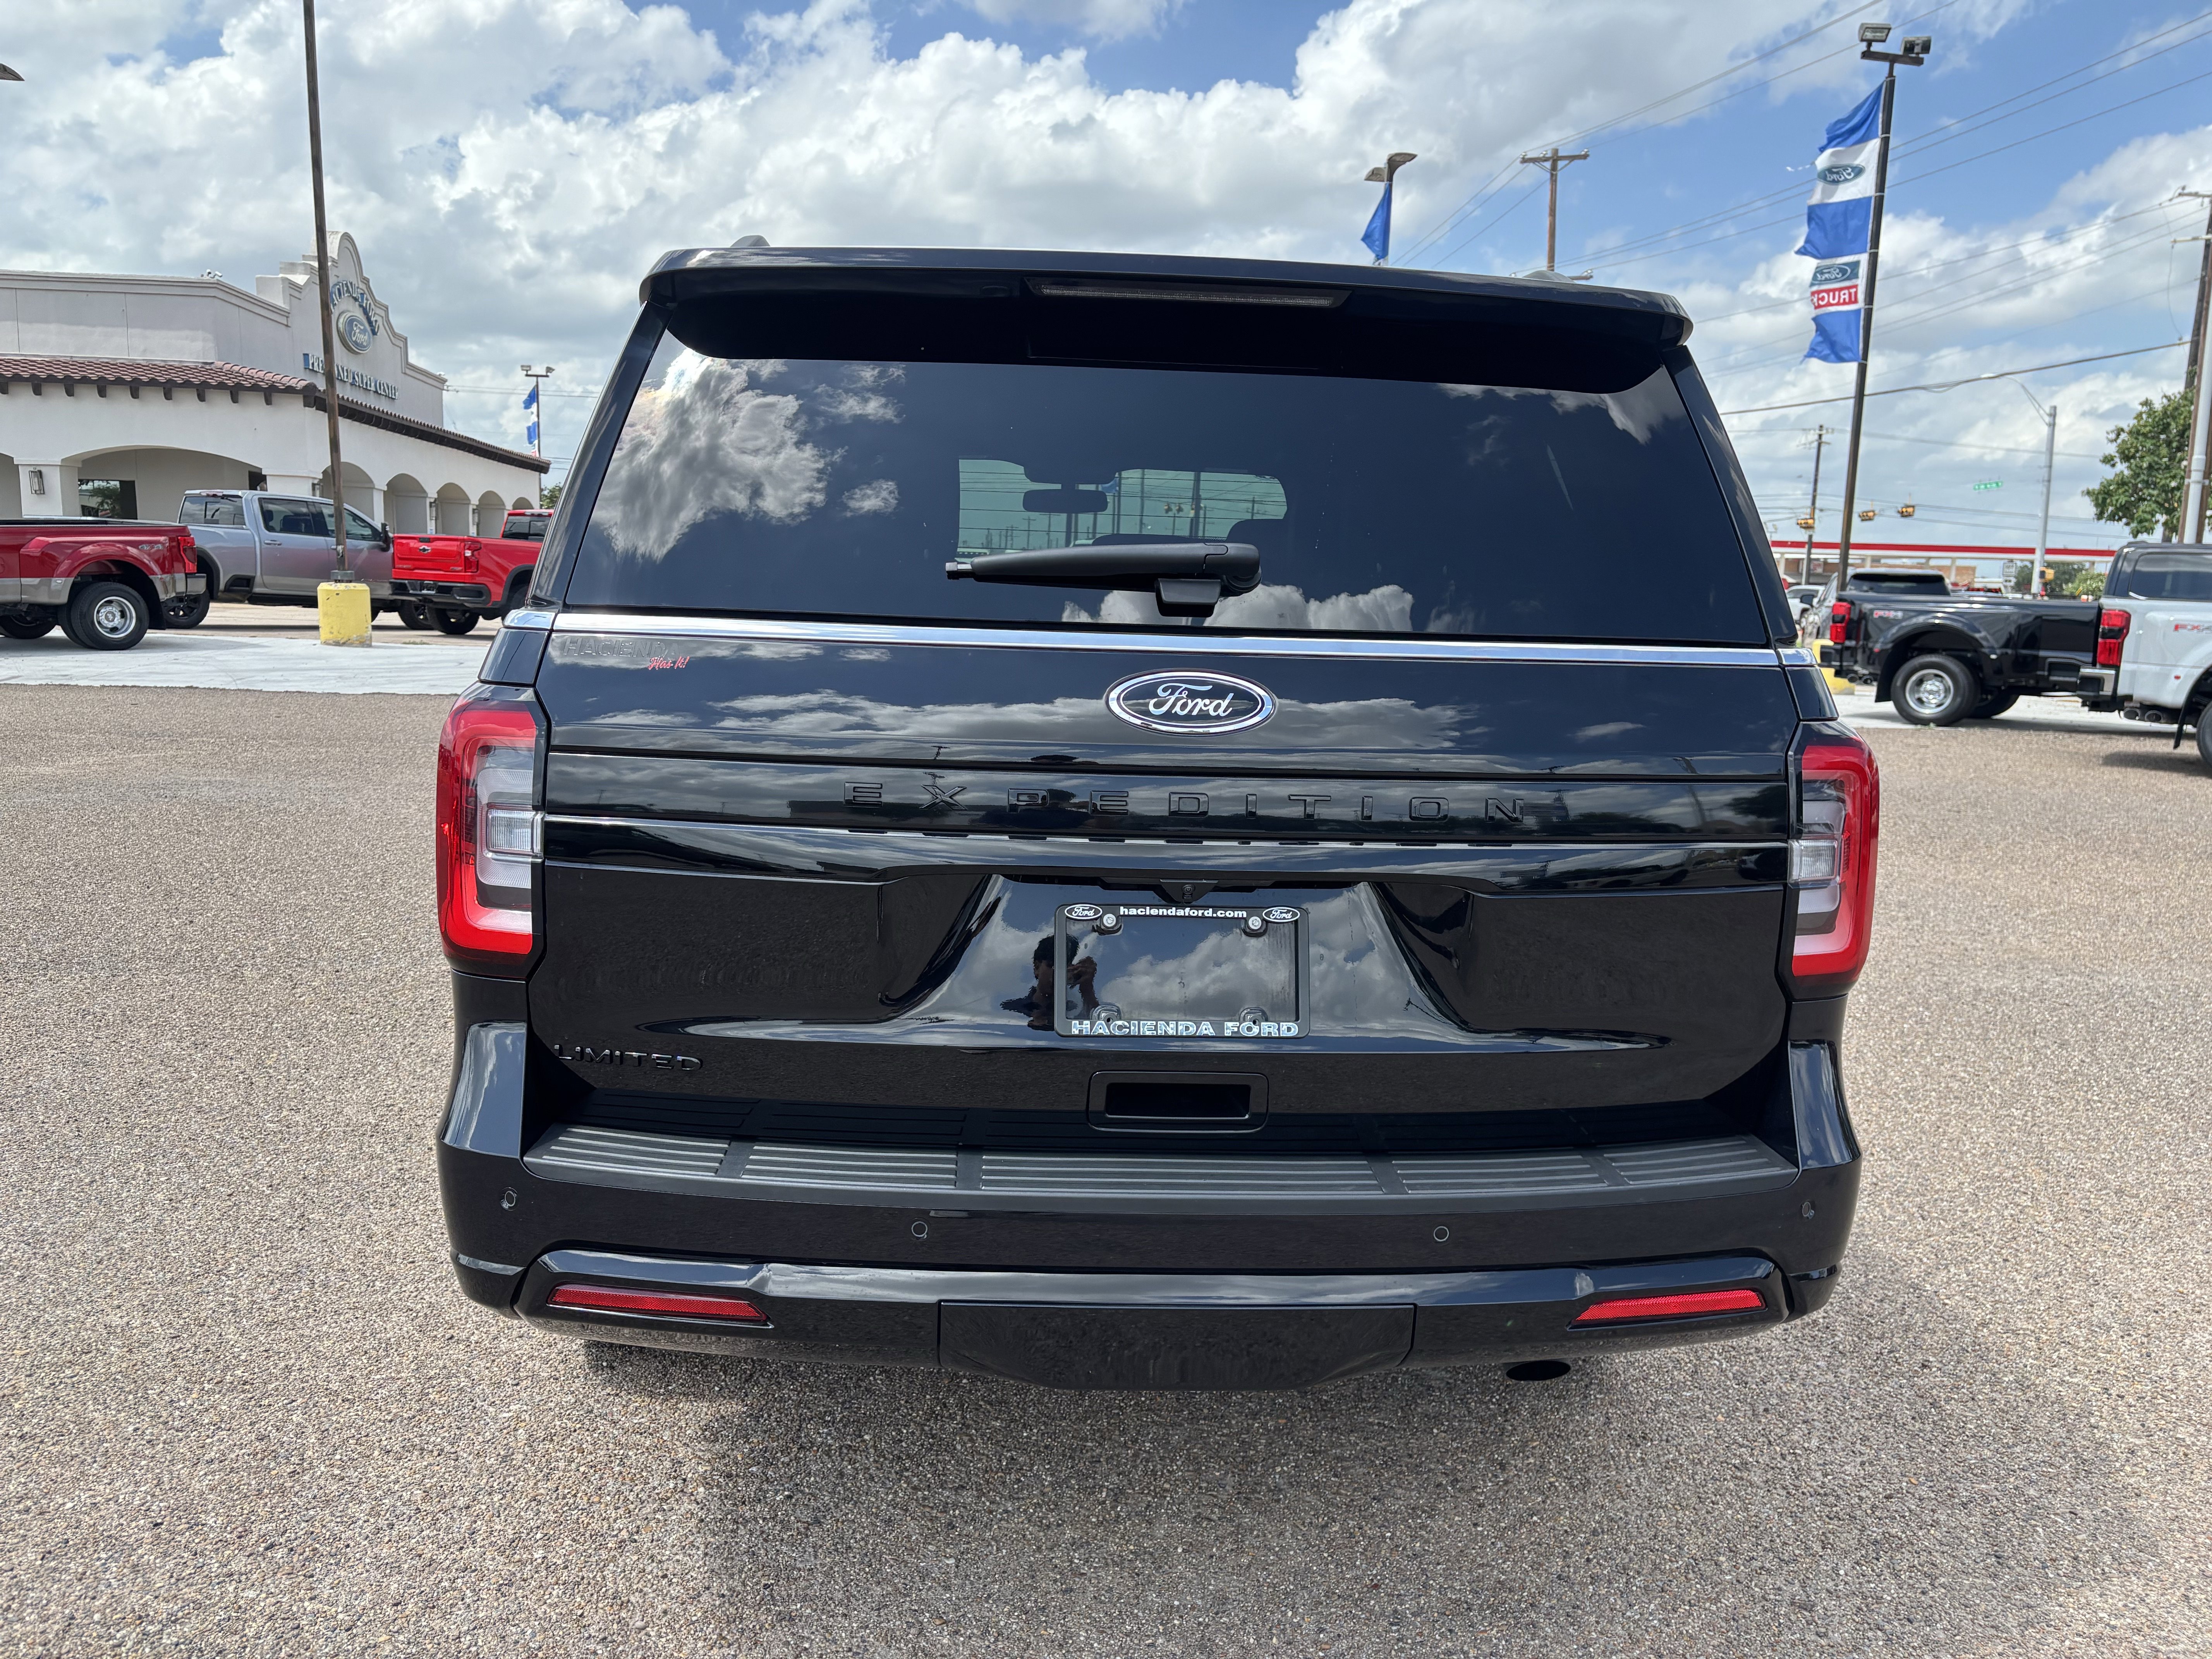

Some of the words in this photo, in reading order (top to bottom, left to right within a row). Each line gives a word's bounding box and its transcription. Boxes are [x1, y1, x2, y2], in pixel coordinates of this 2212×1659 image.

[330, 281, 361, 312] ACIENDA
[354, 371, 376, 391] SUPER
[377, 380, 399, 400] CENTER
[563, 637, 680, 658] HACIENDA
[648, 657, 673, 670] Has
[674, 656, 690, 669] It!
[1148, 683, 1235, 716] Ford
[843, 781, 1524, 823] EXPEDITION
[1072, 906, 1095, 917] Ford
[1120, 906, 1247, 918] haciendaford.com
[1270, 909, 1292, 920] Ford
[1071, 1020, 1216, 1036] HACIENDA
[1224, 1022, 1298, 1037] FORD
[554, 1044, 703, 1070] LIMITED
